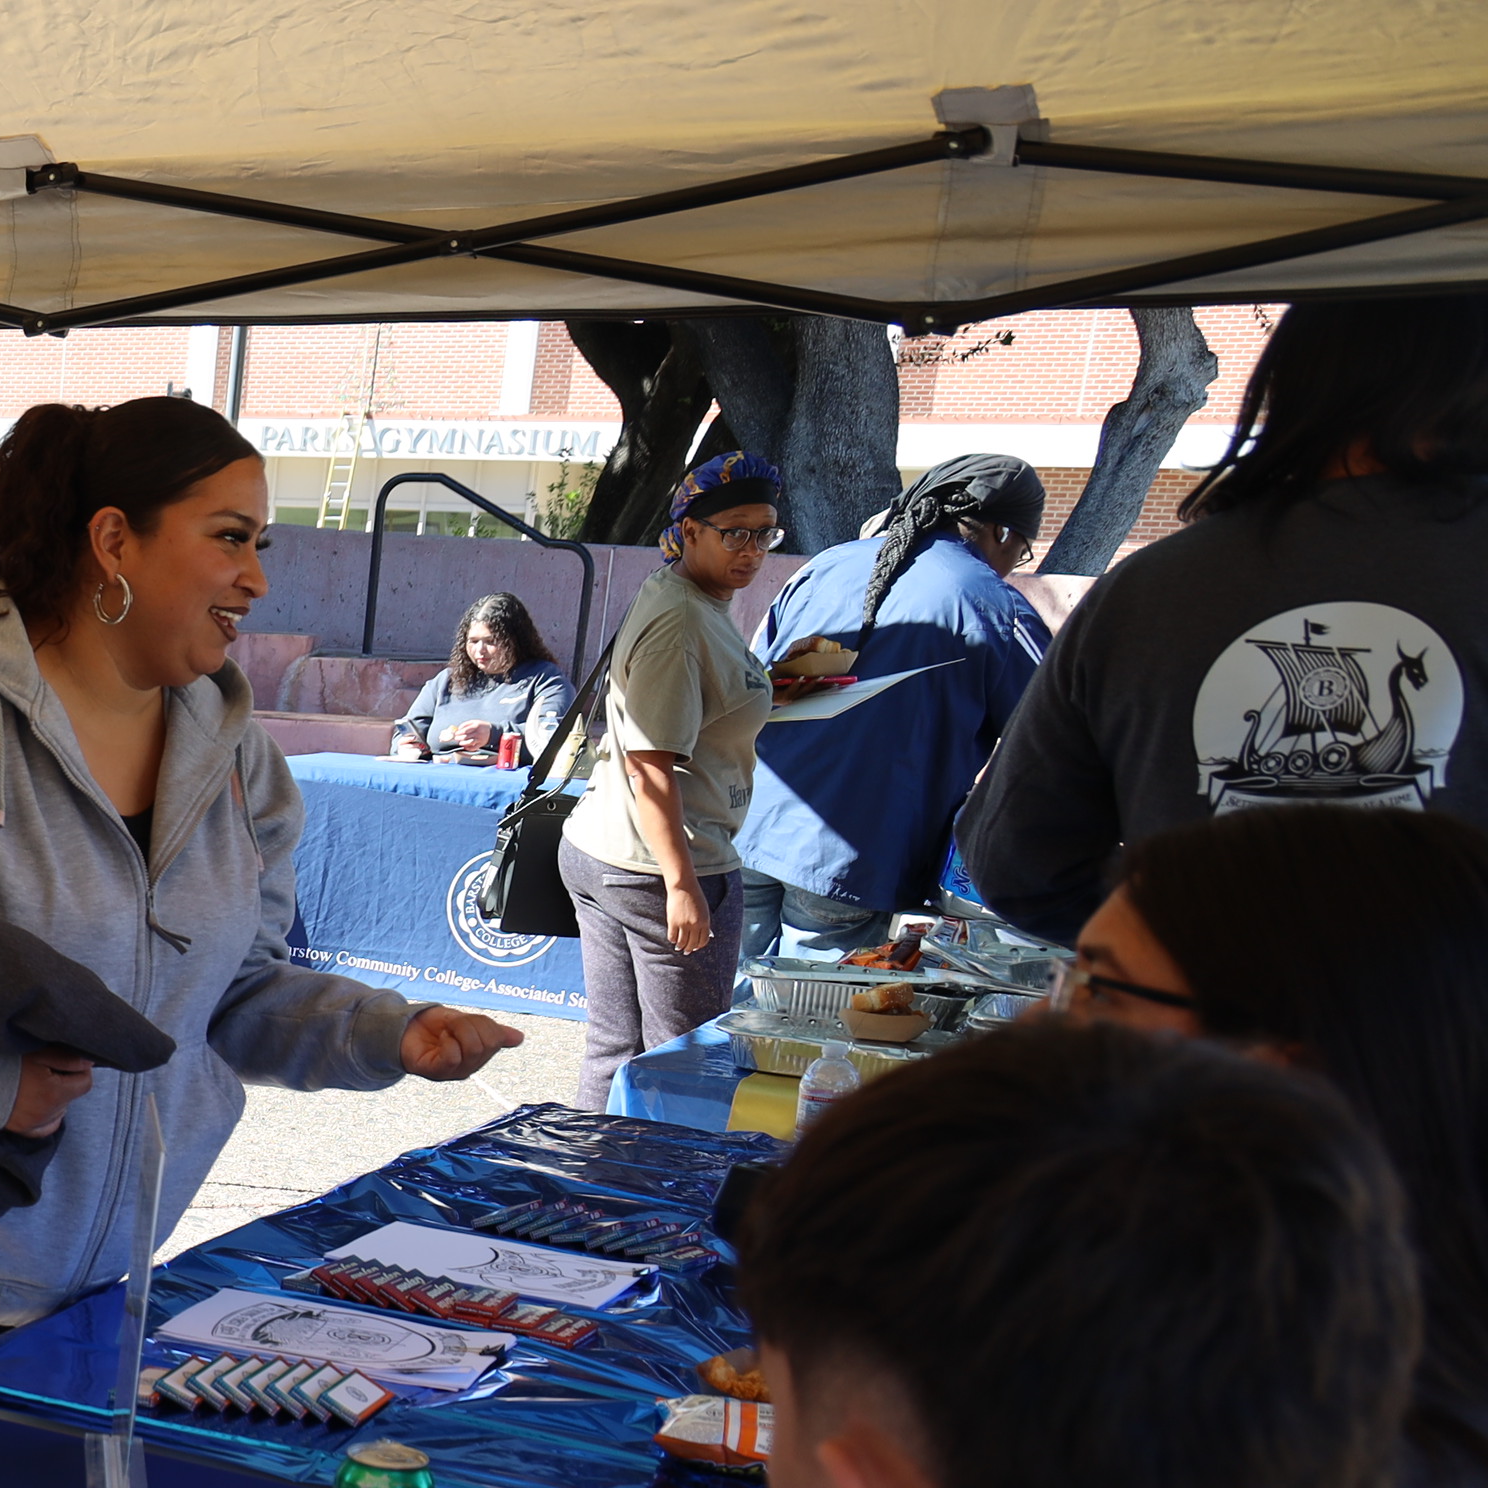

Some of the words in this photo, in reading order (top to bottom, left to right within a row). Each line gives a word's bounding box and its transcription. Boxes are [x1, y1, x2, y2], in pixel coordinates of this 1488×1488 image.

[259, 425, 361, 452] PARKS
[378, 428, 601, 458] GYMNASIUM
[475, 927, 529, 949] COLLEGE
[335, 950, 422, 981] Community
[424, 966, 567, 1006] College-Associated
